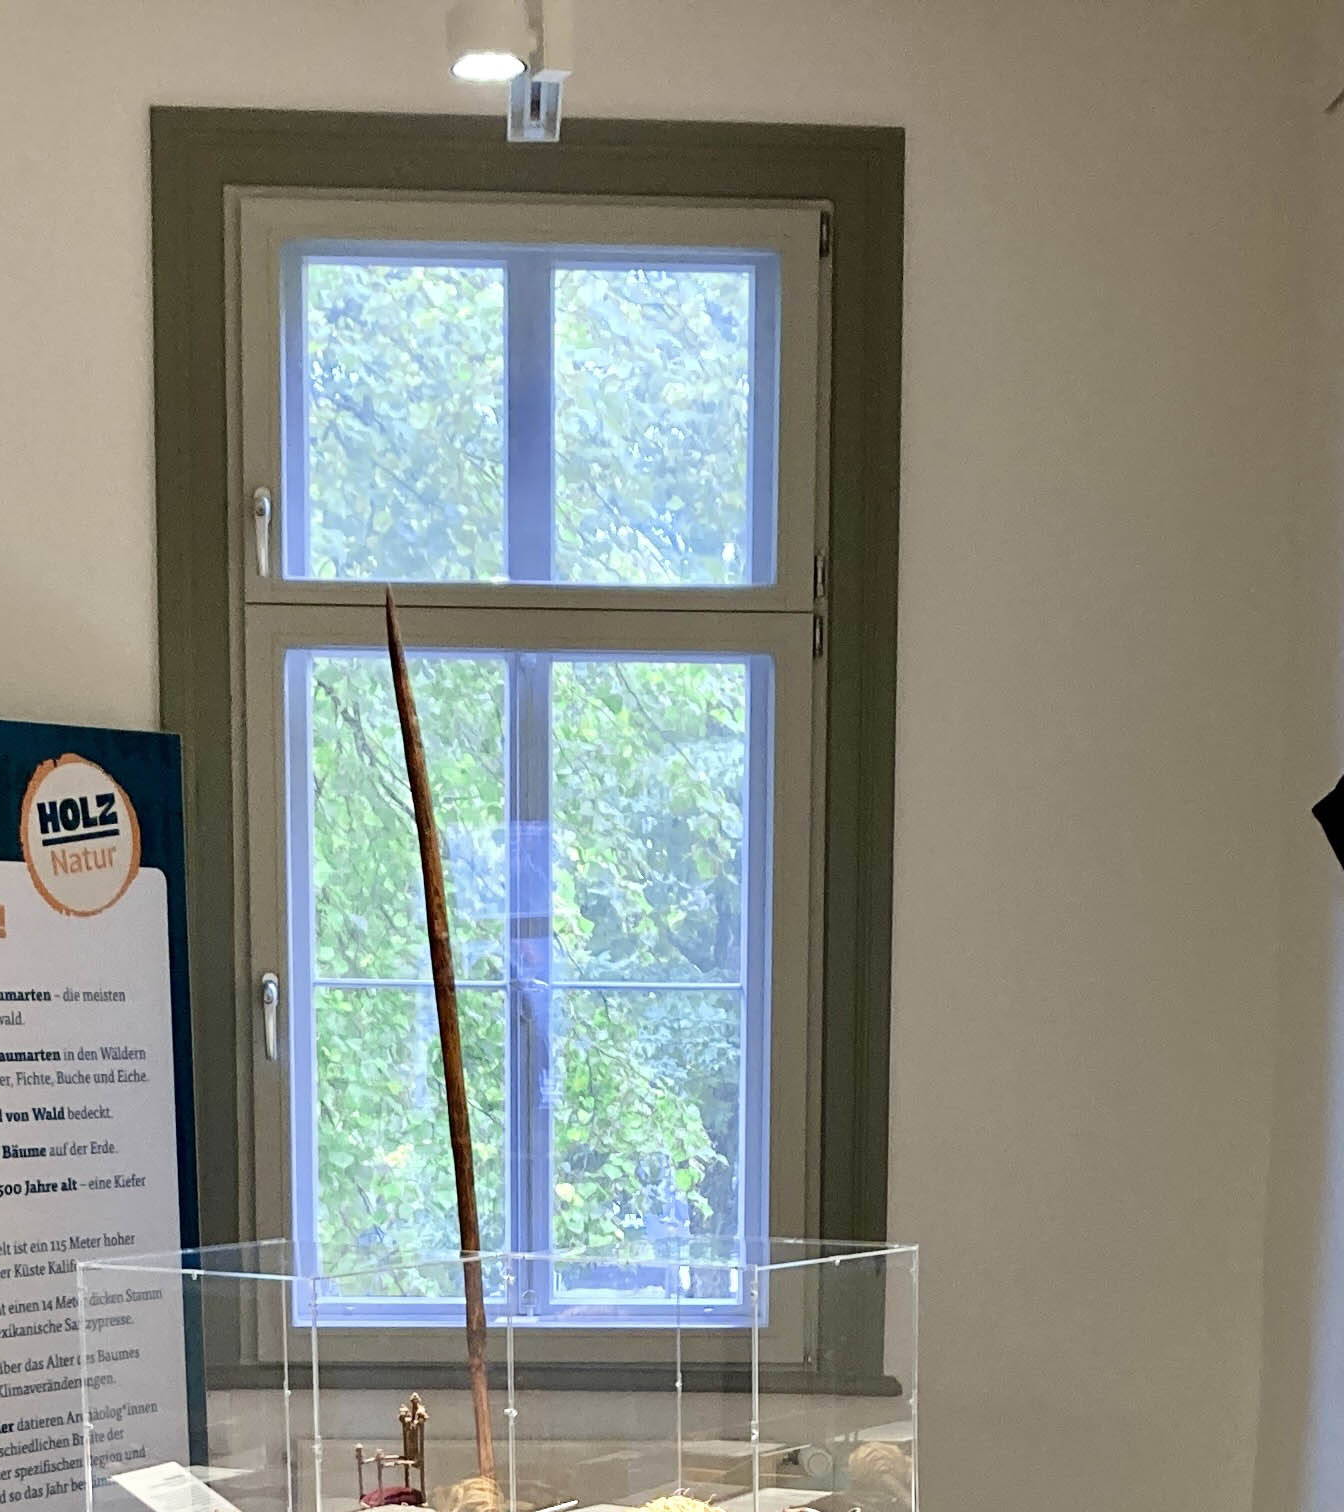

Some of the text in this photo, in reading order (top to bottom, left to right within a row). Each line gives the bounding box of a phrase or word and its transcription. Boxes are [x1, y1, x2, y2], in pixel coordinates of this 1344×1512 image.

[37, 793, 118, 834] HOLZ
[50, 843, 118, 876] Natur
[63, 988, 79, 1001] die
[83, 988, 125, 1001] meisten
[64, 1048, 74, 1061] in
[77, 1048, 97, 1060] den
[100, 1047, 145, 1060] Wäldern
[57, 1071, 90, 1084] Buche
[94, 1071, 114, 1083] und
[6, 1112, 29, 1122] von
[32, 1107, 65, 1121] Wald
[2, 1145, 46, 1158] Bäume
[50, 1143, 66, 1156] auf
[70, 1142, 87, 1155] der
[24, 1180, 58, 1196] Jahre
[61, 1178, 77, 1192] alt
[114, 1174, 146, 1188] Kiefer
[14, 1240, 27, 1254] ist
[30, 1238, 48, 1253] ein
[69, 1236, 101, 1250] Meter
[104, 1233, 135, 1247] hoher
[14, 1263, 45, 1277] Küste
[9, 1300, 39, 1313] einen
[25, 1358, 44, 1372] das
[46, 1356, 75, 1369] Alter
[17, 1414, 64, 1432] datieren
[107, 1429, 124, 1440] der
[15, 1457, 83, 1481] spezifischen
[9, 1492, 22, 1502] so
[24, 1485, 43, 1499] das
[46, 1482, 67, 1498] Jahr
